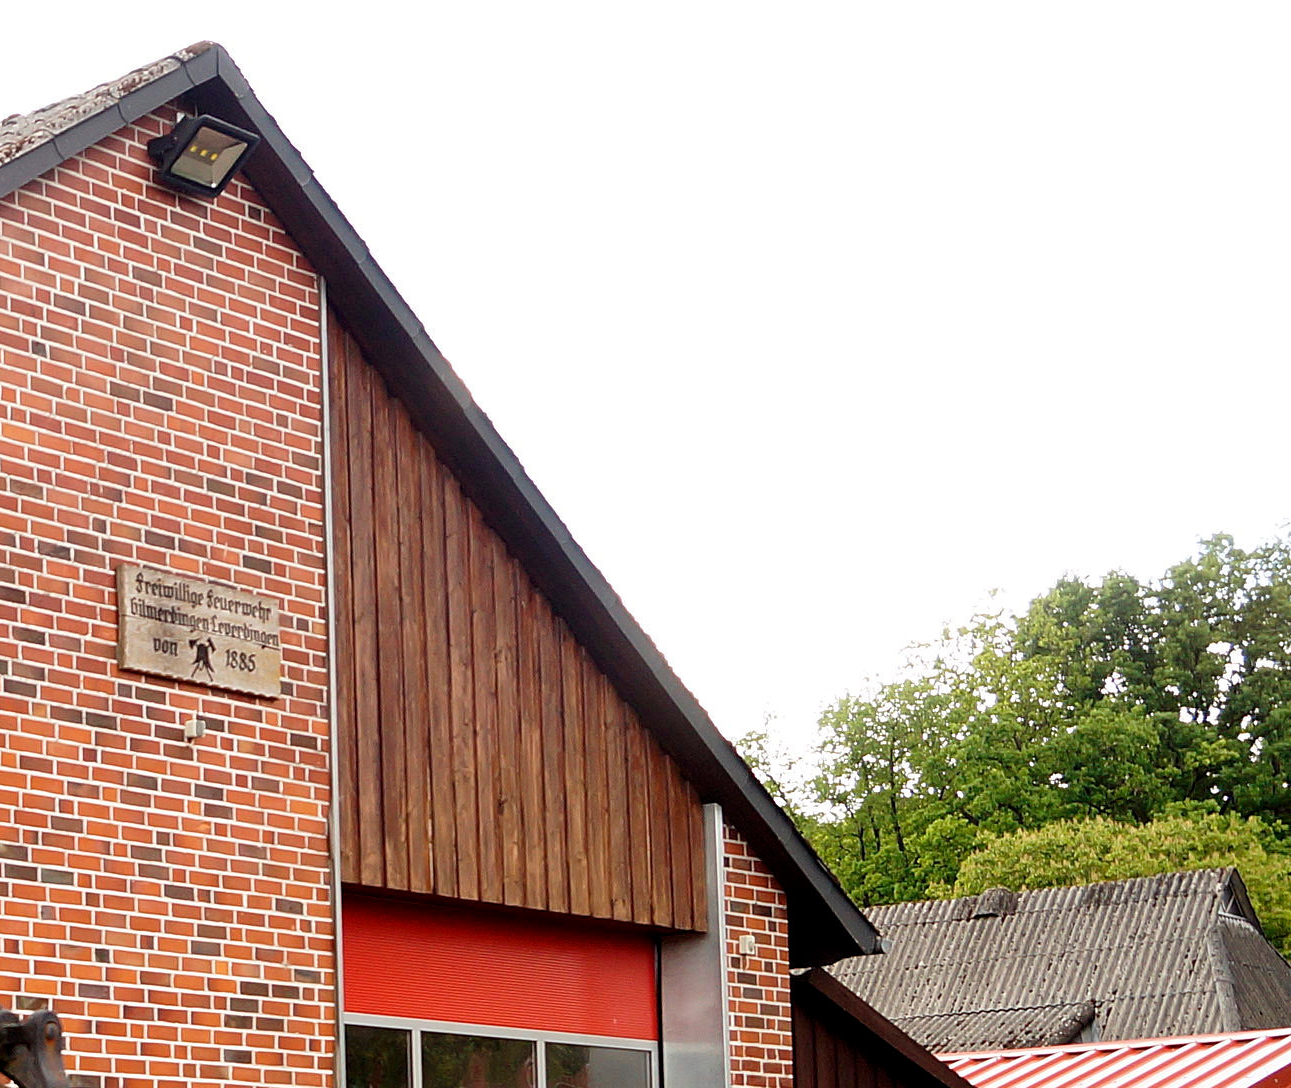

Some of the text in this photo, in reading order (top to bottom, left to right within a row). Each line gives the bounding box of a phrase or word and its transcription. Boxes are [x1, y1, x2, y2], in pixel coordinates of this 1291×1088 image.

[135, 572, 271, 622] Freiwillige Feuerwehr
[153, 637, 256, 672] von 1885
